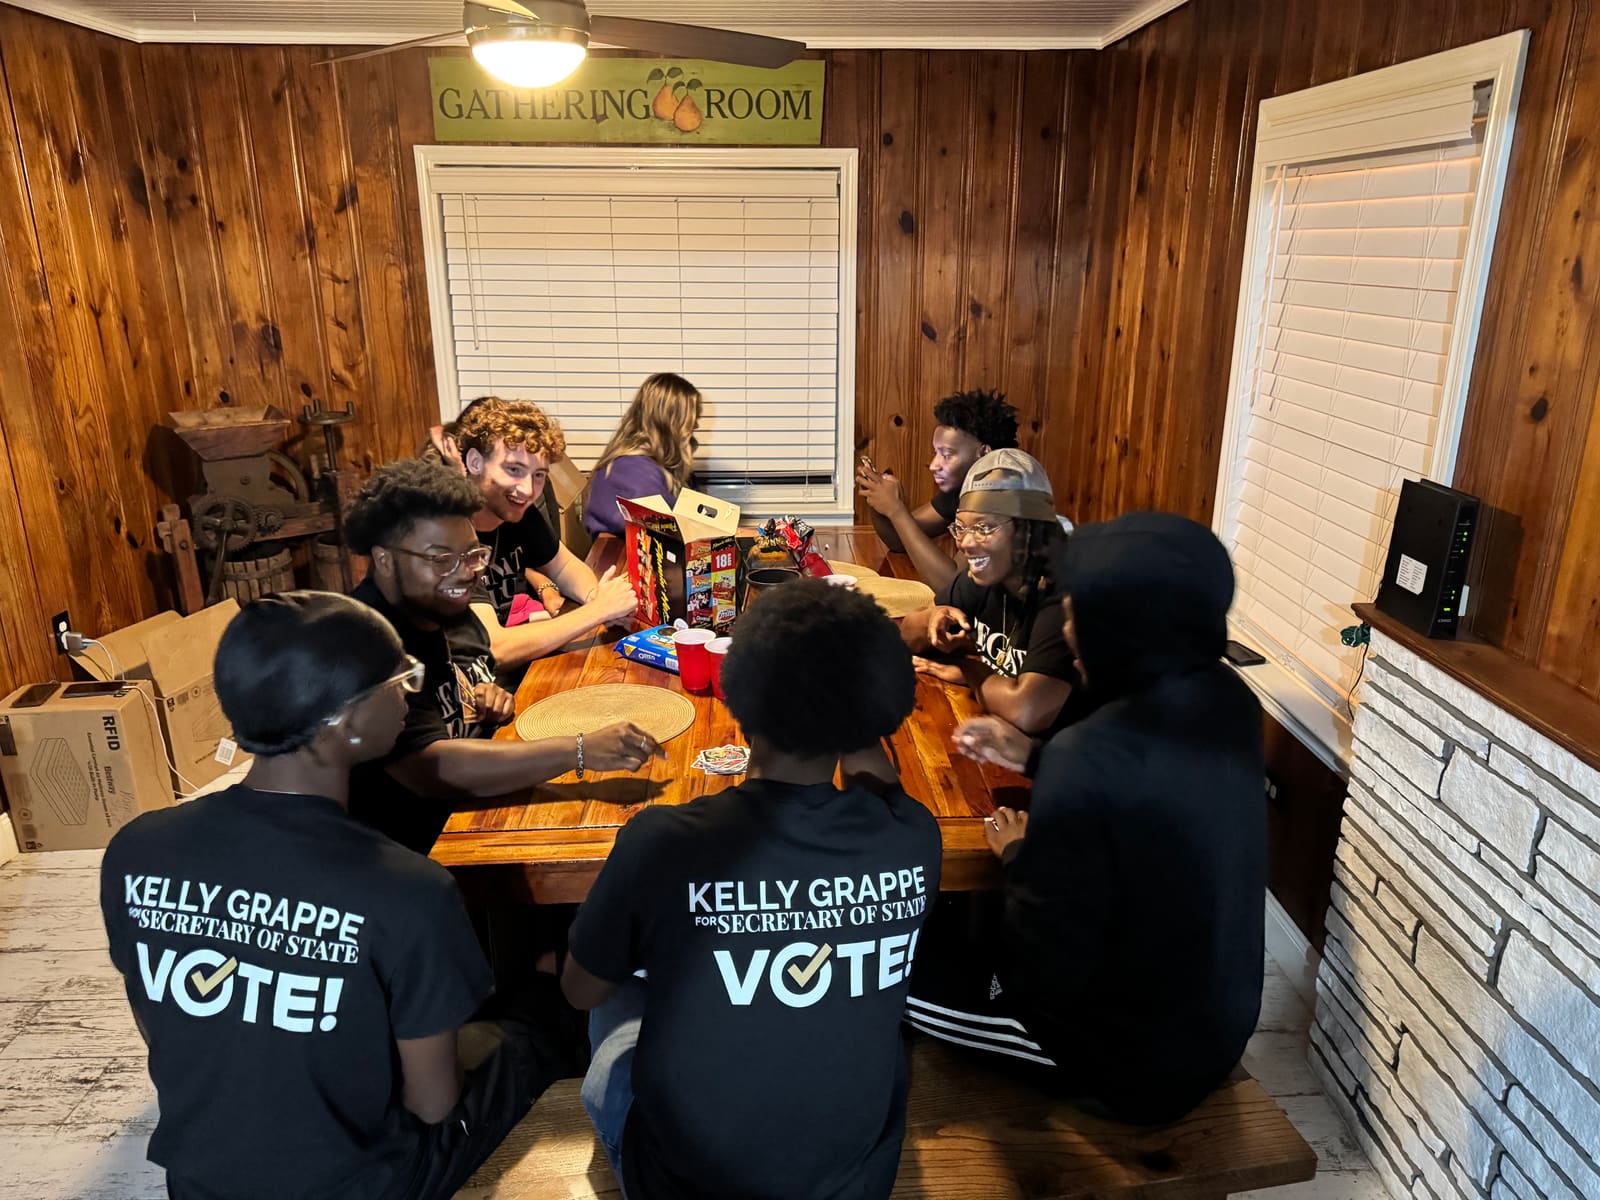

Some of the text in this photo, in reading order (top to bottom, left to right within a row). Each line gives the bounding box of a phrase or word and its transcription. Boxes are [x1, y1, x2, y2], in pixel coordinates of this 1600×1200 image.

[438, 87, 812, 123] GATHERING ROOM
[716, 553, 727, 568] 18
[102, 715, 121, 751] RFID
[124, 874, 365, 945] KELLY GRAPPE
[688, 866, 926, 913] KELLY GRAPPE
[138, 909, 255, 945] SECRETARY
[256, 930, 284, 952] OF
[285, 936, 359, 964] STATE
[695, 895, 927, 934] FOR SECRETARY OF STATE
[136, 942, 344, 1033] VOTE!
[713, 928, 920, 1008] VOTE!
